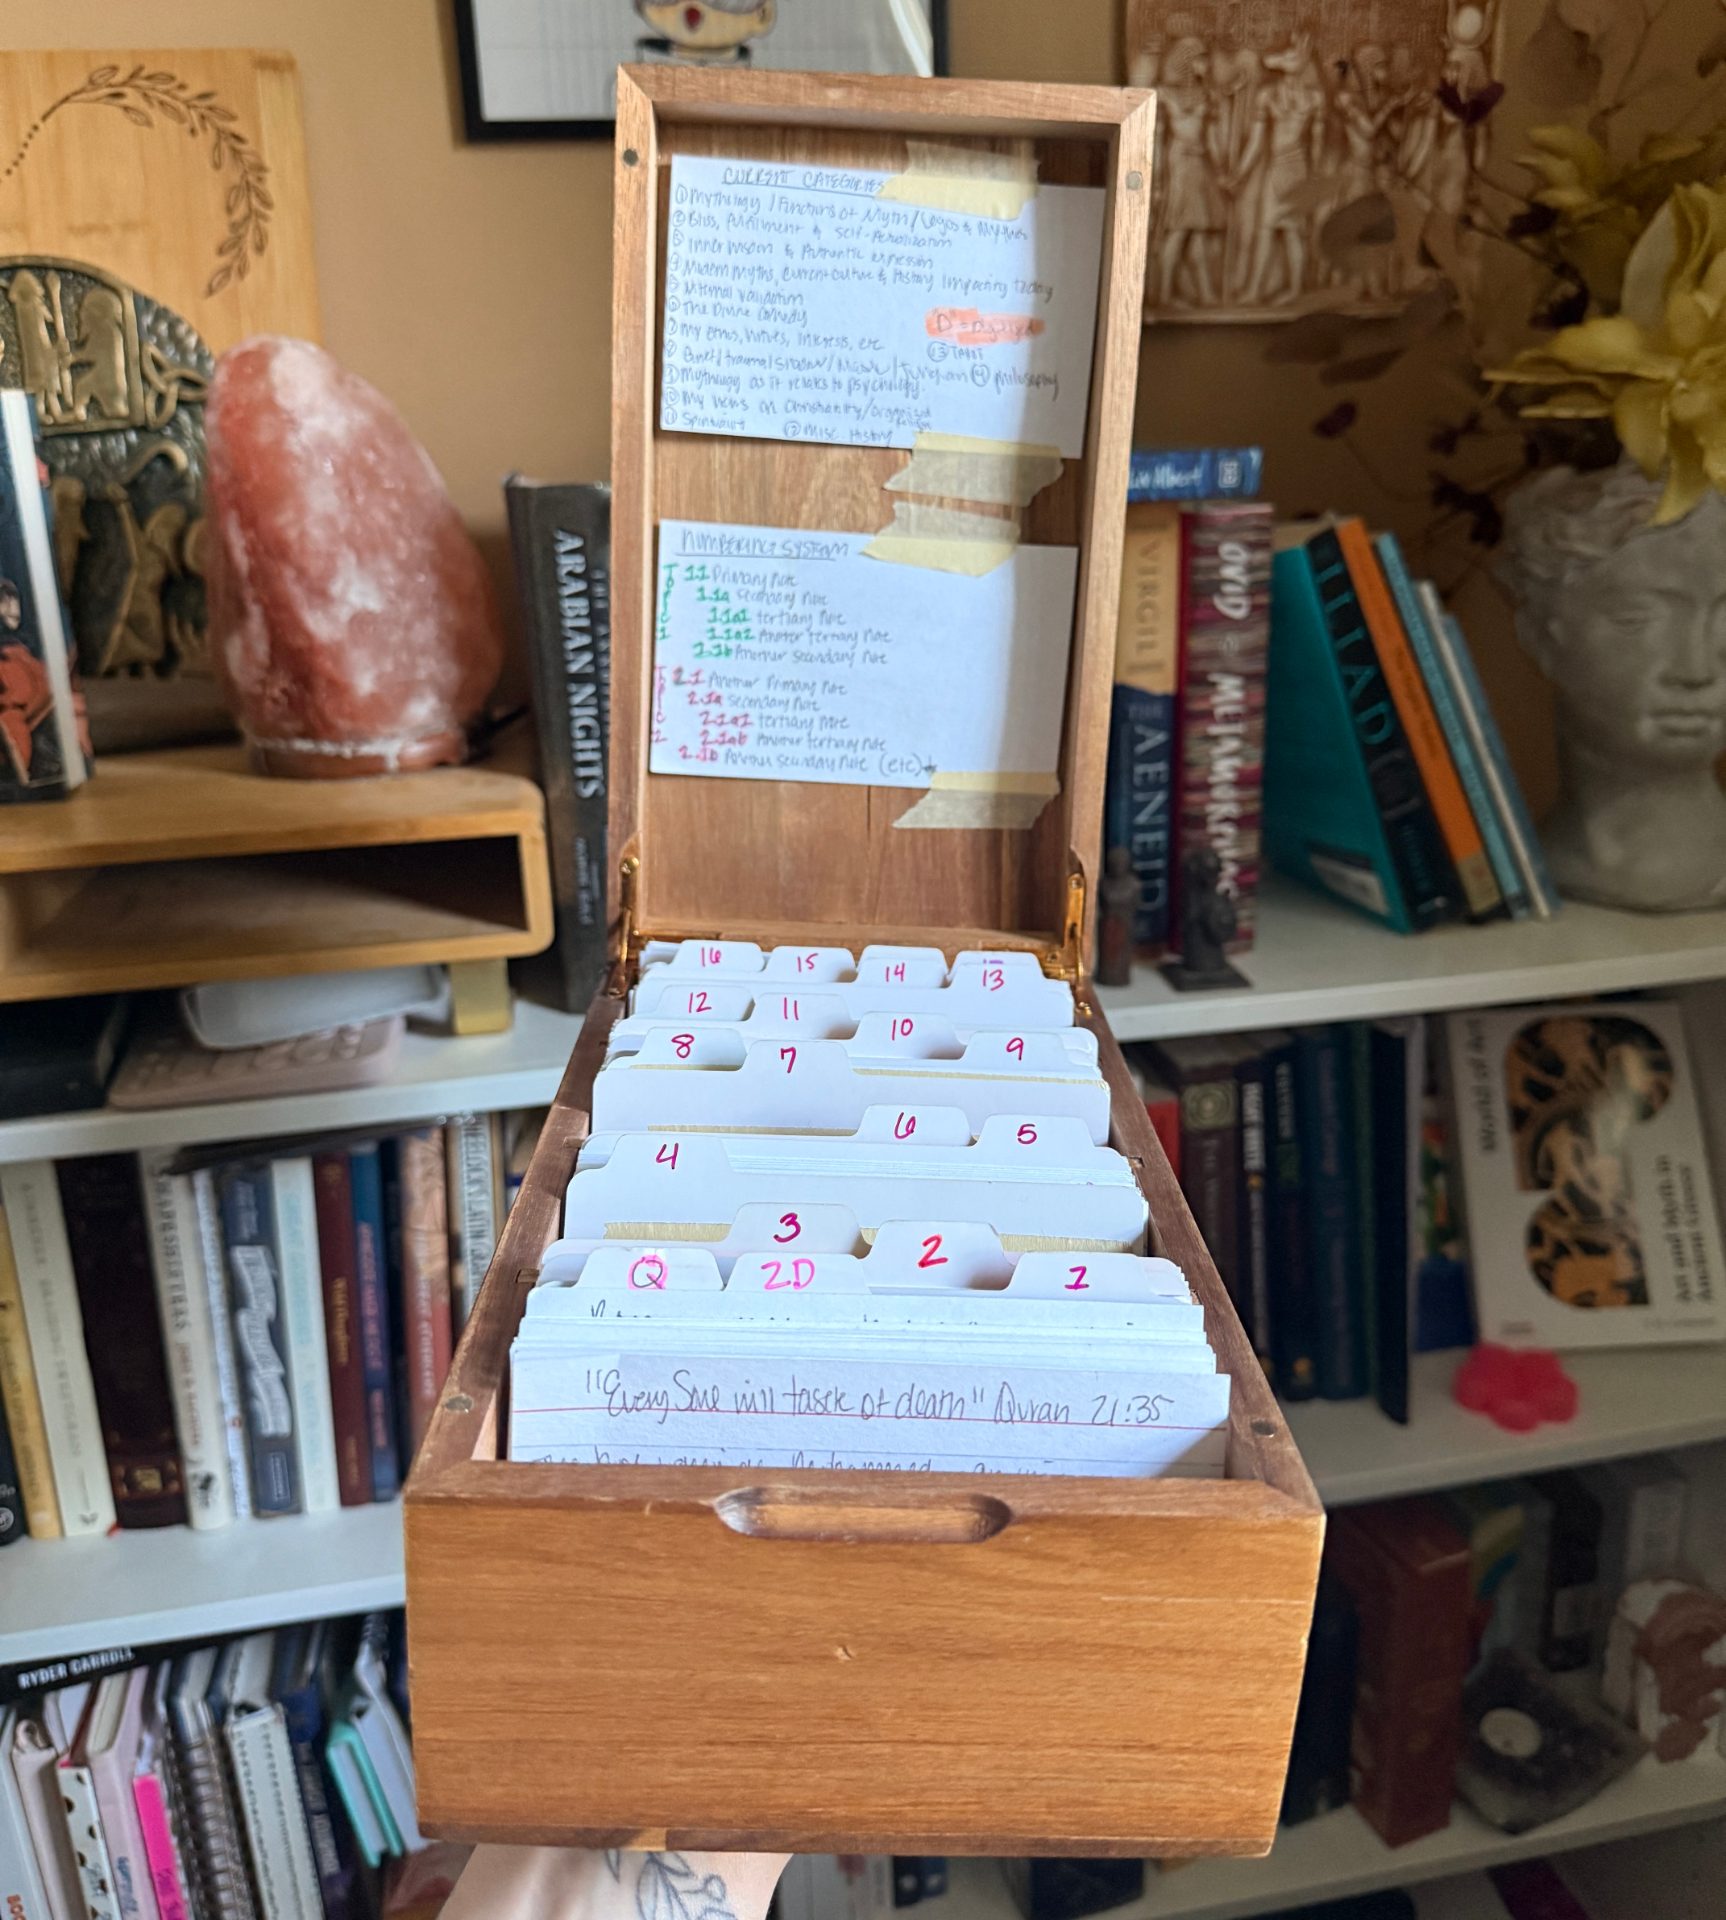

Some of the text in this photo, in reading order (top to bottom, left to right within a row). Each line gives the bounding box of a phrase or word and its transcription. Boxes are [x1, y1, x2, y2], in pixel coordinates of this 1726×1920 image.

[552, 528, 596, 675] ARABIAN
[1135, 539, 1161, 654] VIRGIL
[1213, 541, 1251, 622] OVID
[1315, 562, 1397, 747] ILIAD
[566, 682, 606, 800] NIGHTS
[1131, 724, 1170, 913] AENEID
[700, 945, 1006, 992] 16 15 14 13
[687, 991, 915, 1042] 12 11 10
[670, 1033, 1026, 1074] 8 7 9
[893, 1111, 1039, 1146] 6 5
[654, 1141, 680, 1171] 4
[772, 1212, 802, 1244] 3
[630, 1233, 1090, 1292] Q 2D 2 1
[735, 1379, 774, 1415] will
[861, 1386, 890, 1420] of
[994, 1380, 1071, 1425] Quran
[1090, 1393, 1176, 1427] 21:35
[18, 1645, 136, 1690] RYDER CARROLL
